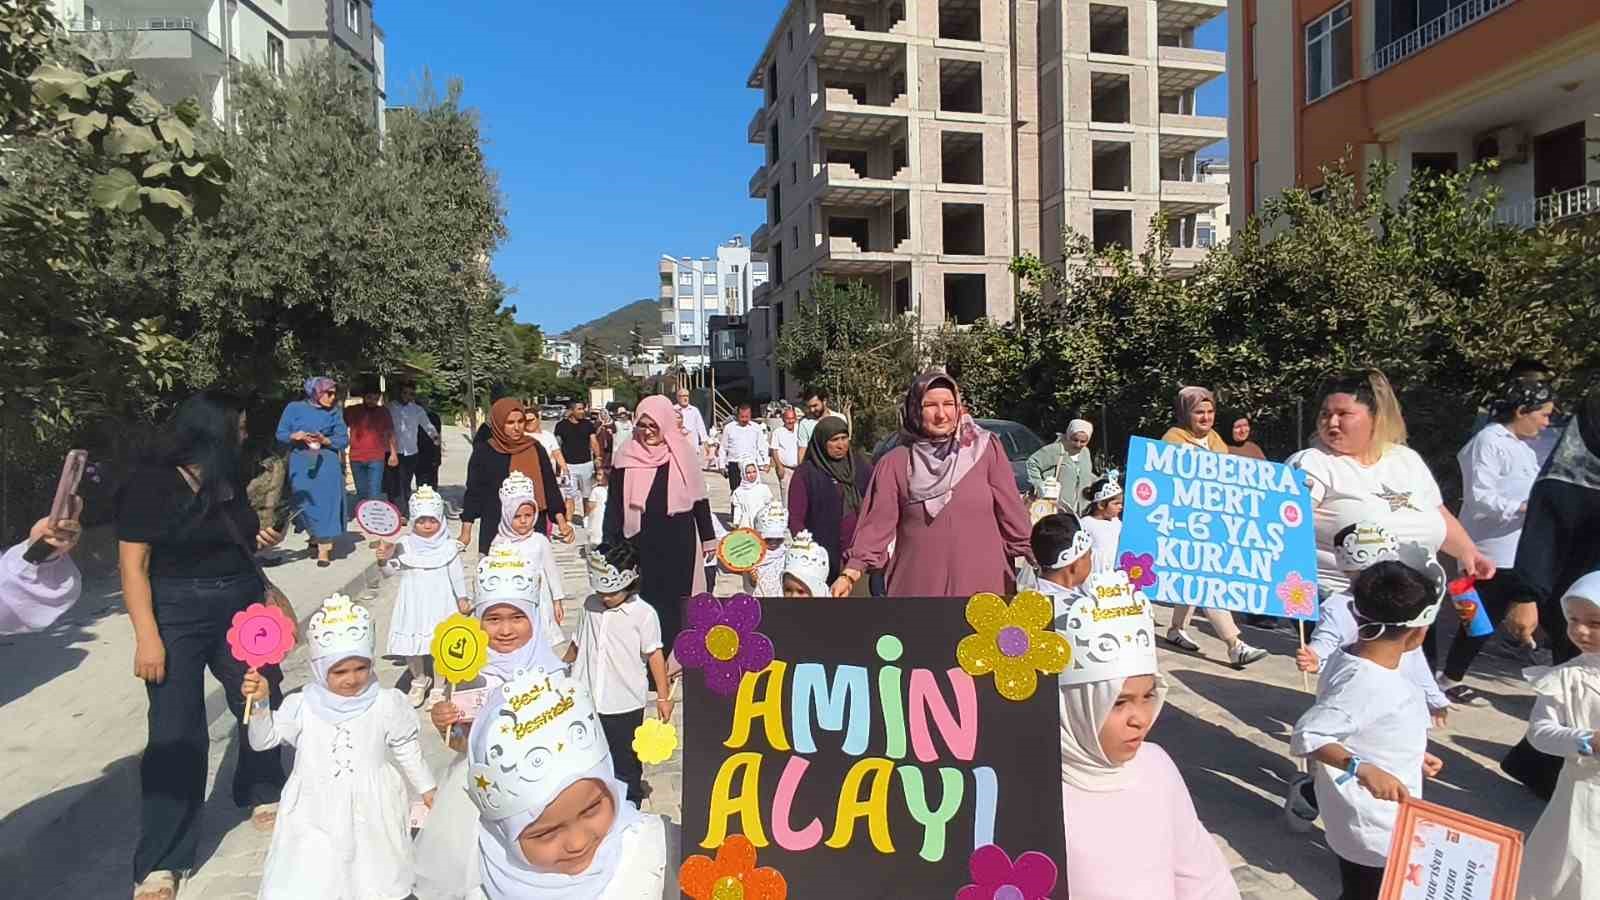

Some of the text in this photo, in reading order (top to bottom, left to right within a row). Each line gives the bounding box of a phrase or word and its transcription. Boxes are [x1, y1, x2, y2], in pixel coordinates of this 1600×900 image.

[1144, 442, 1300, 495] MÜBERRA
[1171, 477, 1266, 518] MERT
[1146, 504, 1285, 561] 4-6 YAŞ
[1155, 571, 1269, 615] KURSU
[699, 751, 999, 863] ALAYI
